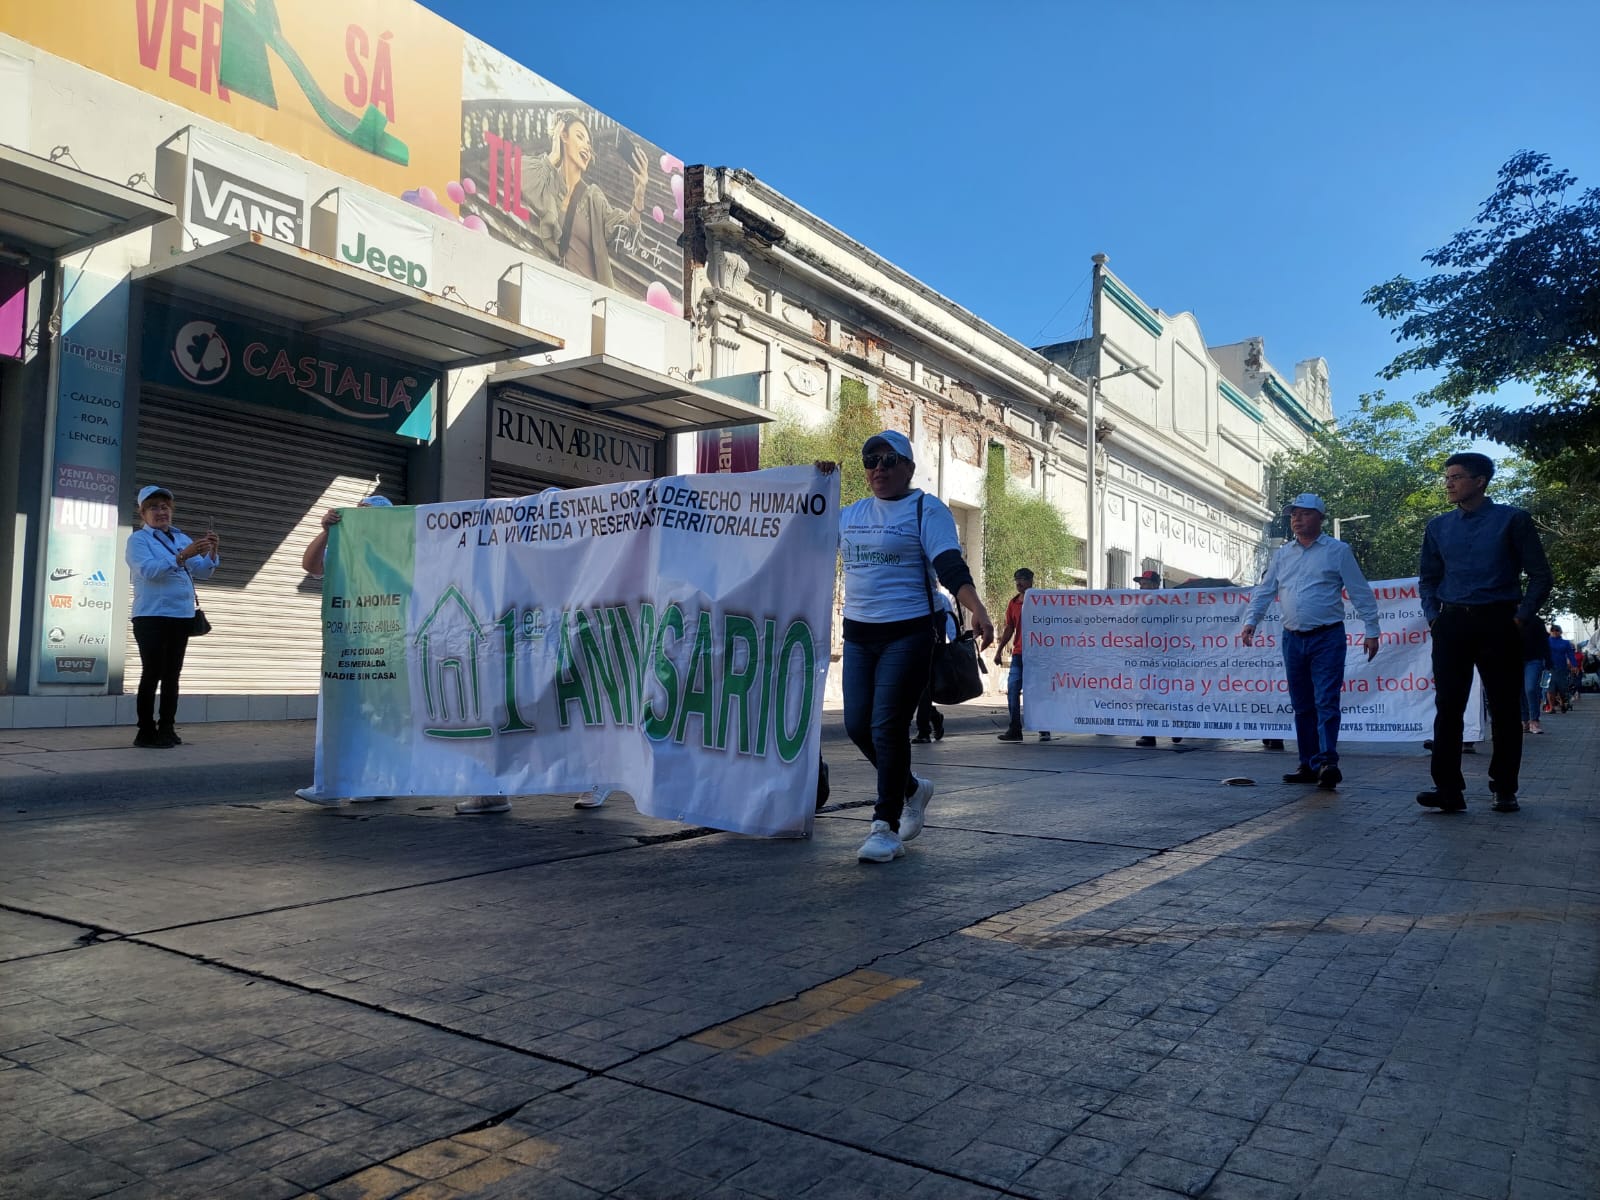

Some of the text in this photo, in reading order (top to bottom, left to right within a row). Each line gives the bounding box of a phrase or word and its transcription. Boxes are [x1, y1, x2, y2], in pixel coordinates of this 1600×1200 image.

[344, 24, 395, 124] SÁ
[484, 130, 531, 222] TIL
[193, 168, 298, 243] VANS
[341, 232, 428, 289] Jeep
[63, 337, 123, 364] impuls
[242, 342, 412, 413] CASTALIA
[70, 392, 121, 408] CALZADO
[81, 413, 109, 426] ROPA
[59, 467, 116, 485] VENTA POR
[59, 478, 115, 493] CATALOGO
[60, 494, 111, 529] AQUÍ
[426, 503, 545, 530] COORDINADORA
[549, 495, 609, 520] ESTATAL
[610, 489, 640, 510] POR
[662, 486, 741, 511] DERECHO
[749, 492, 826, 516] HUMANO
[458, 531, 467, 548] A
[477, 529, 498, 546] LA
[504, 522, 573, 543] VIVIENDA
[576, 520, 588, 537] Y
[656, 507, 780, 538] TERRITORIALES
[55, 567, 73, 577] NIKE
[49, 595, 73, 609] VANS
[78, 597, 111, 610] Jeep
[356, 594, 401, 607] AHOME
[1030, 594, 1114, 606] VIVIENDA
[1120, 591, 1190, 606] DIGNA!
[1197, 591, 1216, 605] ES
[1032, 615, 1073, 625] Exigimos
[1084, 614, 1139, 626] gobernador
[1141, 614, 1180, 626] cumplir
[1195, 616, 1240, 625] promesa
[1398, 609, 1415, 619] los
[78, 633, 105, 645] flexi
[1030, 631, 1055, 647] No
[1060, 631, 1096, 647] más
[1101, 630, 1196, 652] desalojos,
[1202, 635, 1228, 648] no
[358, 648, 385, 656] CIUDAD
[338, 660, 386, 668] ESMERALDA
[1124, 659, 1138, 667] no
[1139, 658, 1160, 668] más
[1162, 658, 1218, 668] violaciones
[1219, 658, 1229, 668] al
[1231, 658, 1273, 668] derecho
[324, 671, 397, 680] NADIE SIN CASA!
[1139, 674, 1196, 695] digna
[1201, 679, 1213, 696] y
[1217, 674, 1288, 693] decoro
[1094, 699, 1133, 710] Vecinos
[1135, 700, 1194, 713] precaristas
[1196, 702, 1211, 712] de
[1212, 702, 1248, 713] VALLE
[1251, 703, 1276, 714] DEL
[1117, 718, 1144, 727] ESTATAL
[1146, 719, 1159, 728] POR
[1161, 719, 1170, 728] EL
[1172, 720, 1201, 729] DERECHO
[1203, 720, 1233, 730] HUMANO
[1243, 722, 1258, 731] UNA
[1259, 722, 1293, 731] VIVIENDA
[1365, 722, 1423, 732] TERRITORIALES
